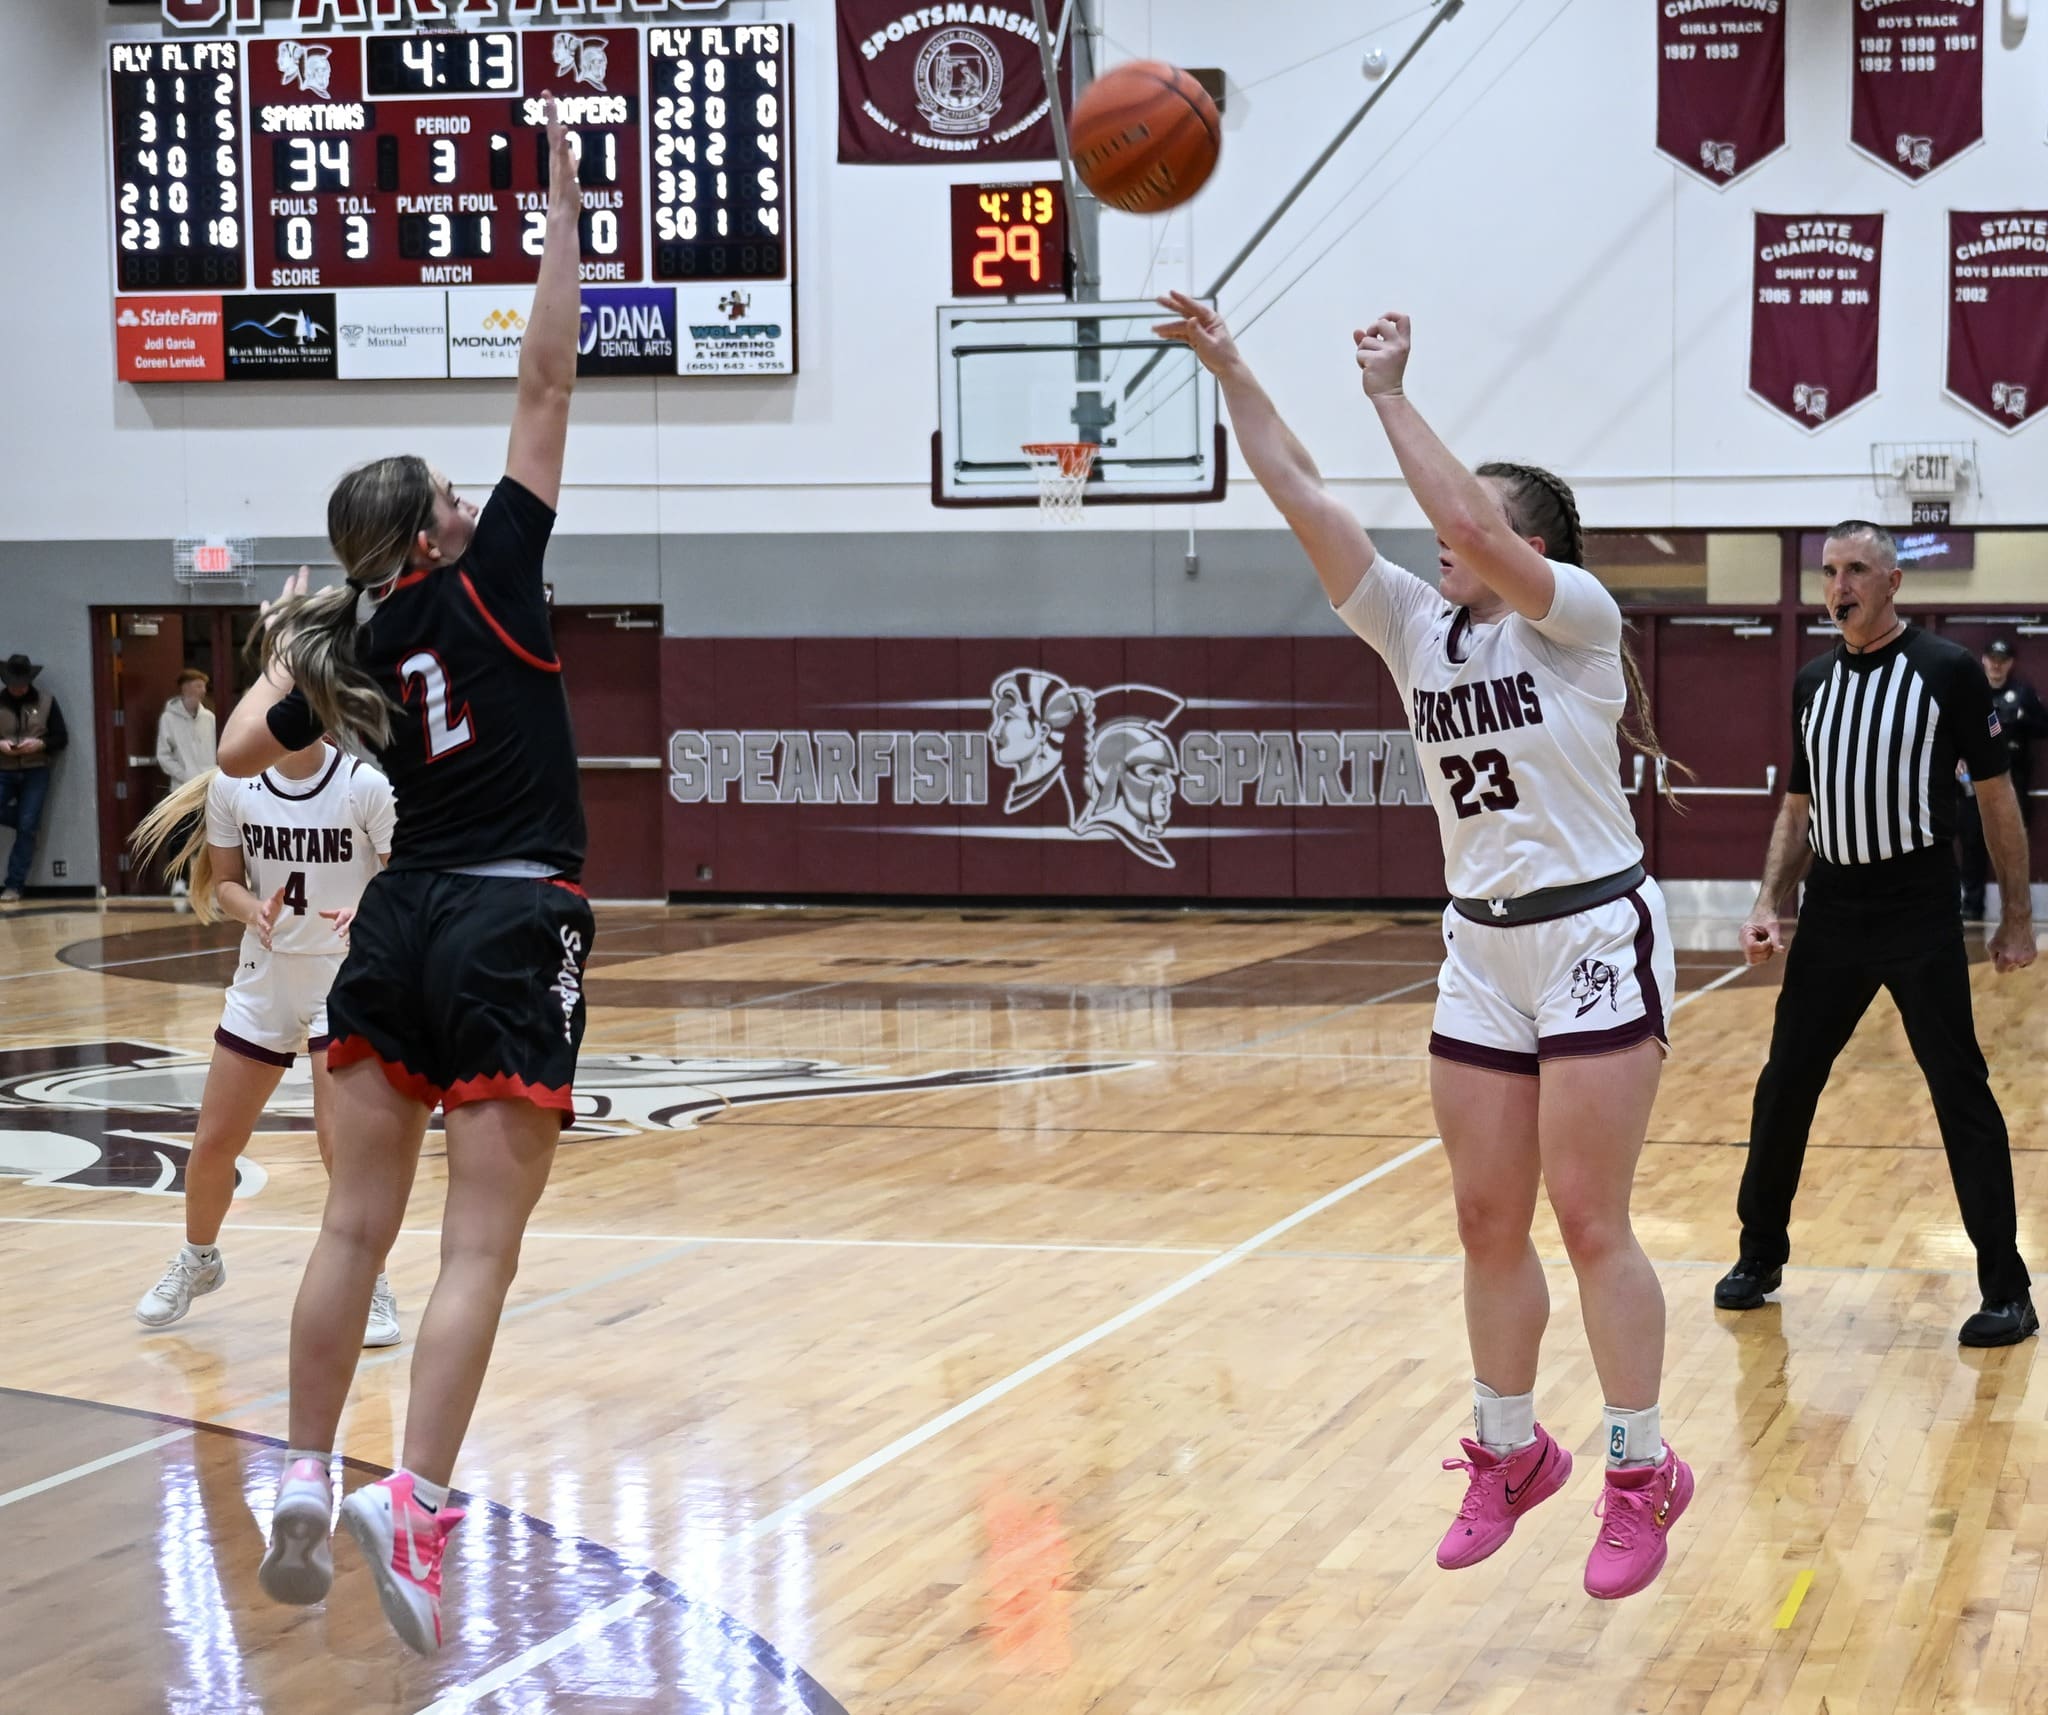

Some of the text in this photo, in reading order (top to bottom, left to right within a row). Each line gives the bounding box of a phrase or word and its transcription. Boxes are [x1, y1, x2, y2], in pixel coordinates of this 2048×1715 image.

[1680, 22, 1763, 35] GIRLS TRACK
[1877, 15, 1959, 28] BOYS TRACK
[113, 43, 236, 72] PLY FL PTS
[650, 26, 779, 57] PLY FL PTS
[402, 34, 513, 89] 4:13
[674, 58, 777, 93] 2 0 4
[146, 73, 234, 105] 1 1 2
[139, 109, 235, 143] 3 1 5
[261, 103, 365, 132] SPARTANS
[415, 116, 471, 135] PERIOD
[654, 93, 777, 130] 22 0 0
[862, 100, 899, 133] TODAY
[911, 131, 980, 152] YESTERDAY
[138, 145, 236, 178] 4 0 6
[289, 138, 350, 192] 34
[433, 139, 456, 183] 3
[655, 132, 778, 167] 24 2 4
[120, 181, 237, 214] 21 0 3
[658, 167, 778, 204] 33 1 5
[270, 198, 318, 216] FOULS
[337, 196, 376, 214] T.O.L.
[397, 193, 498, 214] PLAYER FOUL
[979, 188, 1052, 224] 4:13
[121, 216, 238, 250] 23 1 18
[287, 217, 312, 260] 0
[345, 216, 369, 259] 3
[428, 214, 451, 257] 3
[480, 215, 492, 254] 1
[522, 211, 547, 256] 2
[591, 210, 618, 254] 0
[655, 206, 779, 240] 50 1 4
[1785, 221, 1852, 239] STATE
[1980, 218, 2048, 237] STATE
[973, 226, 1039, 287] 29
[1760, 238, 1875, 262] CHAMPIONS
[1955, 235, 2048, 261] CHAMPIO
[271, 268, 320, 286] SCORE
[421, 265, 473, 283] MATCH
[578, 262, 626, 281] SCORE
[1775, 268, 1858, 280] SPIRIT OF SIX
[1955, 265, 1989, 278] BOYS
[367, 324, 445, 335] Northwestern
[599, 305, 666, 340] DANA
[144, 336, 196, 351] Jodi Garcia
[368, 336, 407, 347] Mutual
[601, 339, 673, 358] DENTAL ARTS
[695, 341, 775, 350] PLUMBING
[710, 350, 775, 359] HEATING
[686, 361, 719, 372] (605)
[1916, 455, 1949, 480] EXIT
[1913, 509, 1949, 523] 2067
[399, 649, 476, 764] 2
[1413, 671, 1543, 743] SPARTANS
[669, 730, 988, 804] SPEARFISH
[1180, 730, 1434, 805] SPARTA
[1440, 749, 1520, 819] 23
[242, 822, 353, 864] SPARTANS
[283, 871, 308, 916] 4
